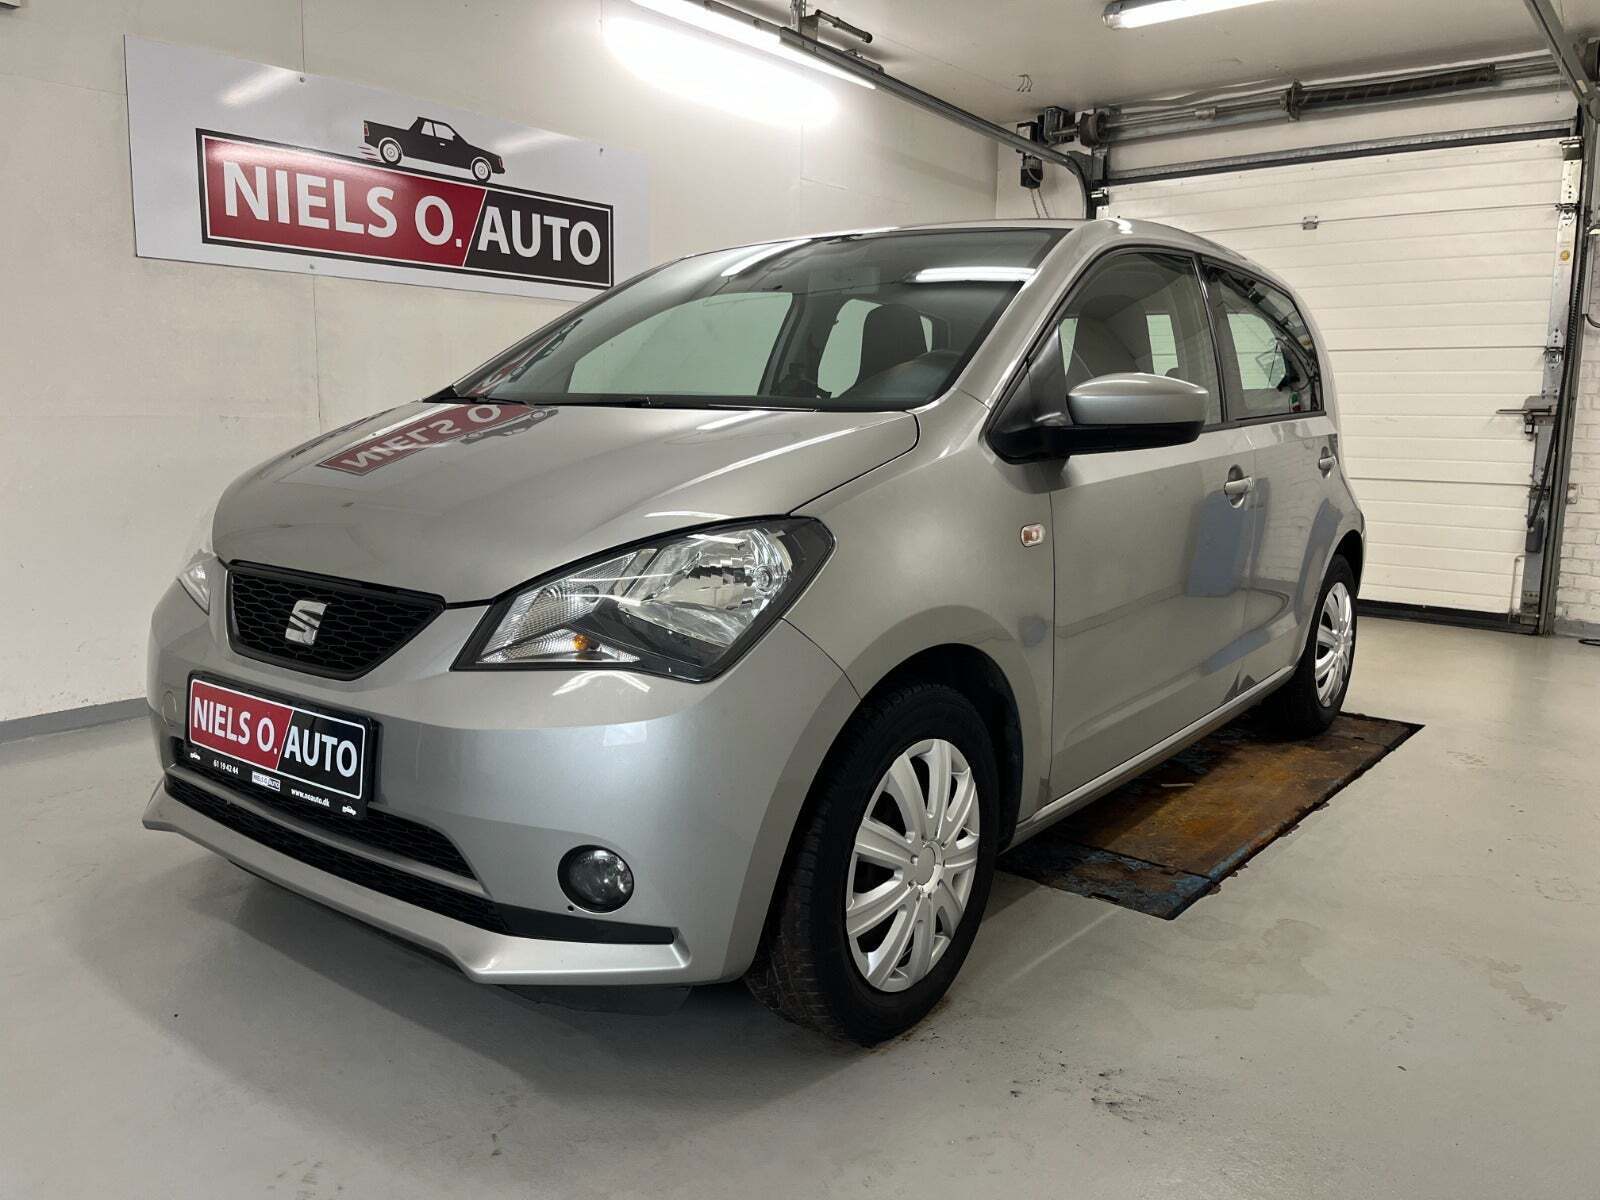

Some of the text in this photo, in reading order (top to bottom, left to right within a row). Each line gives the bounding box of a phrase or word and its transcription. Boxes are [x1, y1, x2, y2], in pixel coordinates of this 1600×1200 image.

[223, 161, 601, 266] NIELS O. AUTO
[193, 697, 358, 778] NIELS O. AUTO
